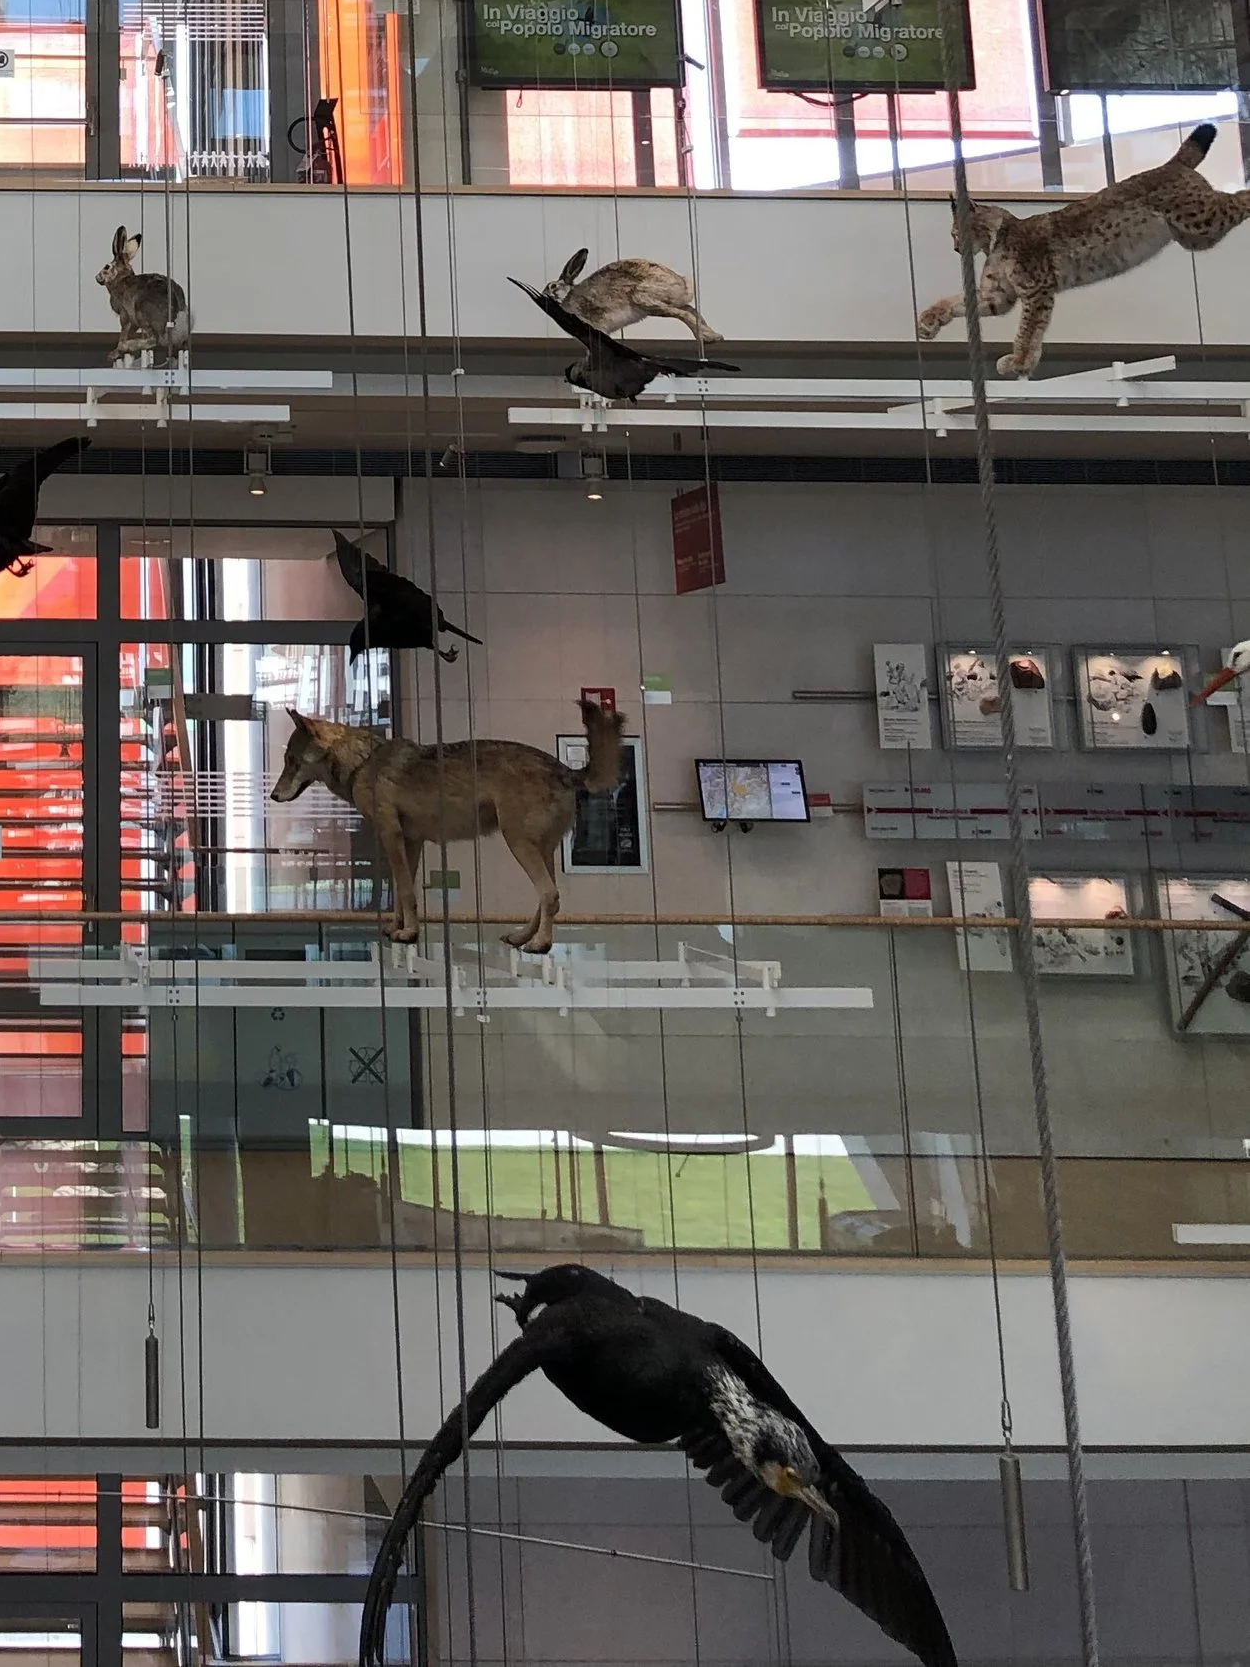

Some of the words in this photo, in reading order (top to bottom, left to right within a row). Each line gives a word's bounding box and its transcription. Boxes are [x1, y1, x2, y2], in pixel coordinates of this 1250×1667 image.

[482, 4, 500, 20] In
[505, 3, 579, 24] Viaggio
[771, 6, 790, 23] In
[794, 6, 868, 26] Viaggio
[485, 20, 500, 28] col
[500, 20, 564, 38] Popolo
[568, 20, 657, 39] Migratore
[774, 23, 789, 31] col
[789, 22, 853, 41] Popolo
[858, 23, 943, 42] Migratore
